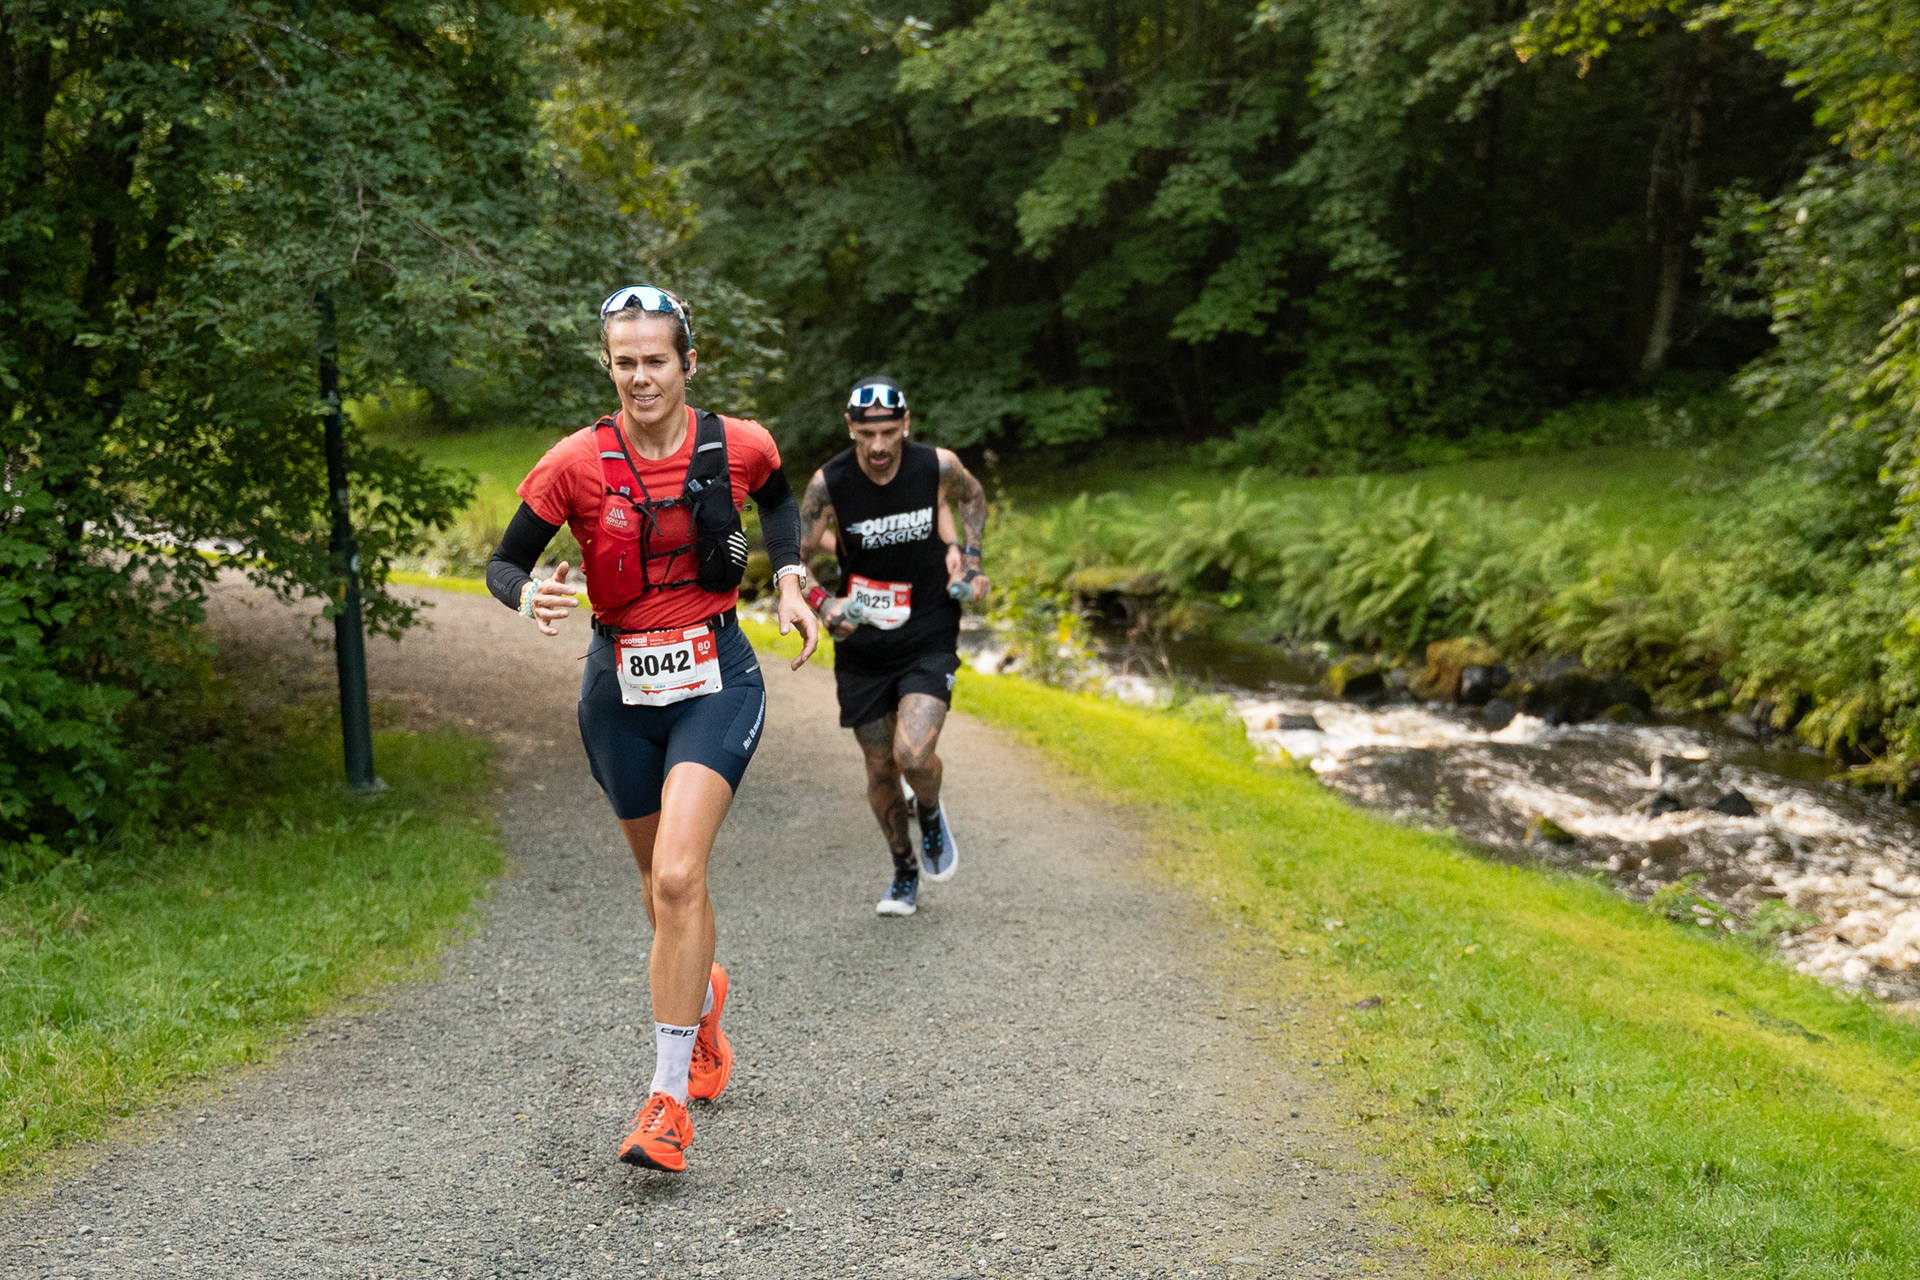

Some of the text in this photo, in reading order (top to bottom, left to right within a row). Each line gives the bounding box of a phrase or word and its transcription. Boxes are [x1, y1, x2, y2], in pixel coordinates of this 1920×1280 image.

[861, 507, 933, 536] OUTRUN
[861, 523, 933, 550] FASCISM
[620, 636, 647, 645] ecotrail
[697, 640, 711, 652] 80
[630, 650, 691, 677] 8042
[661, 1028, 694, 1037] cep
